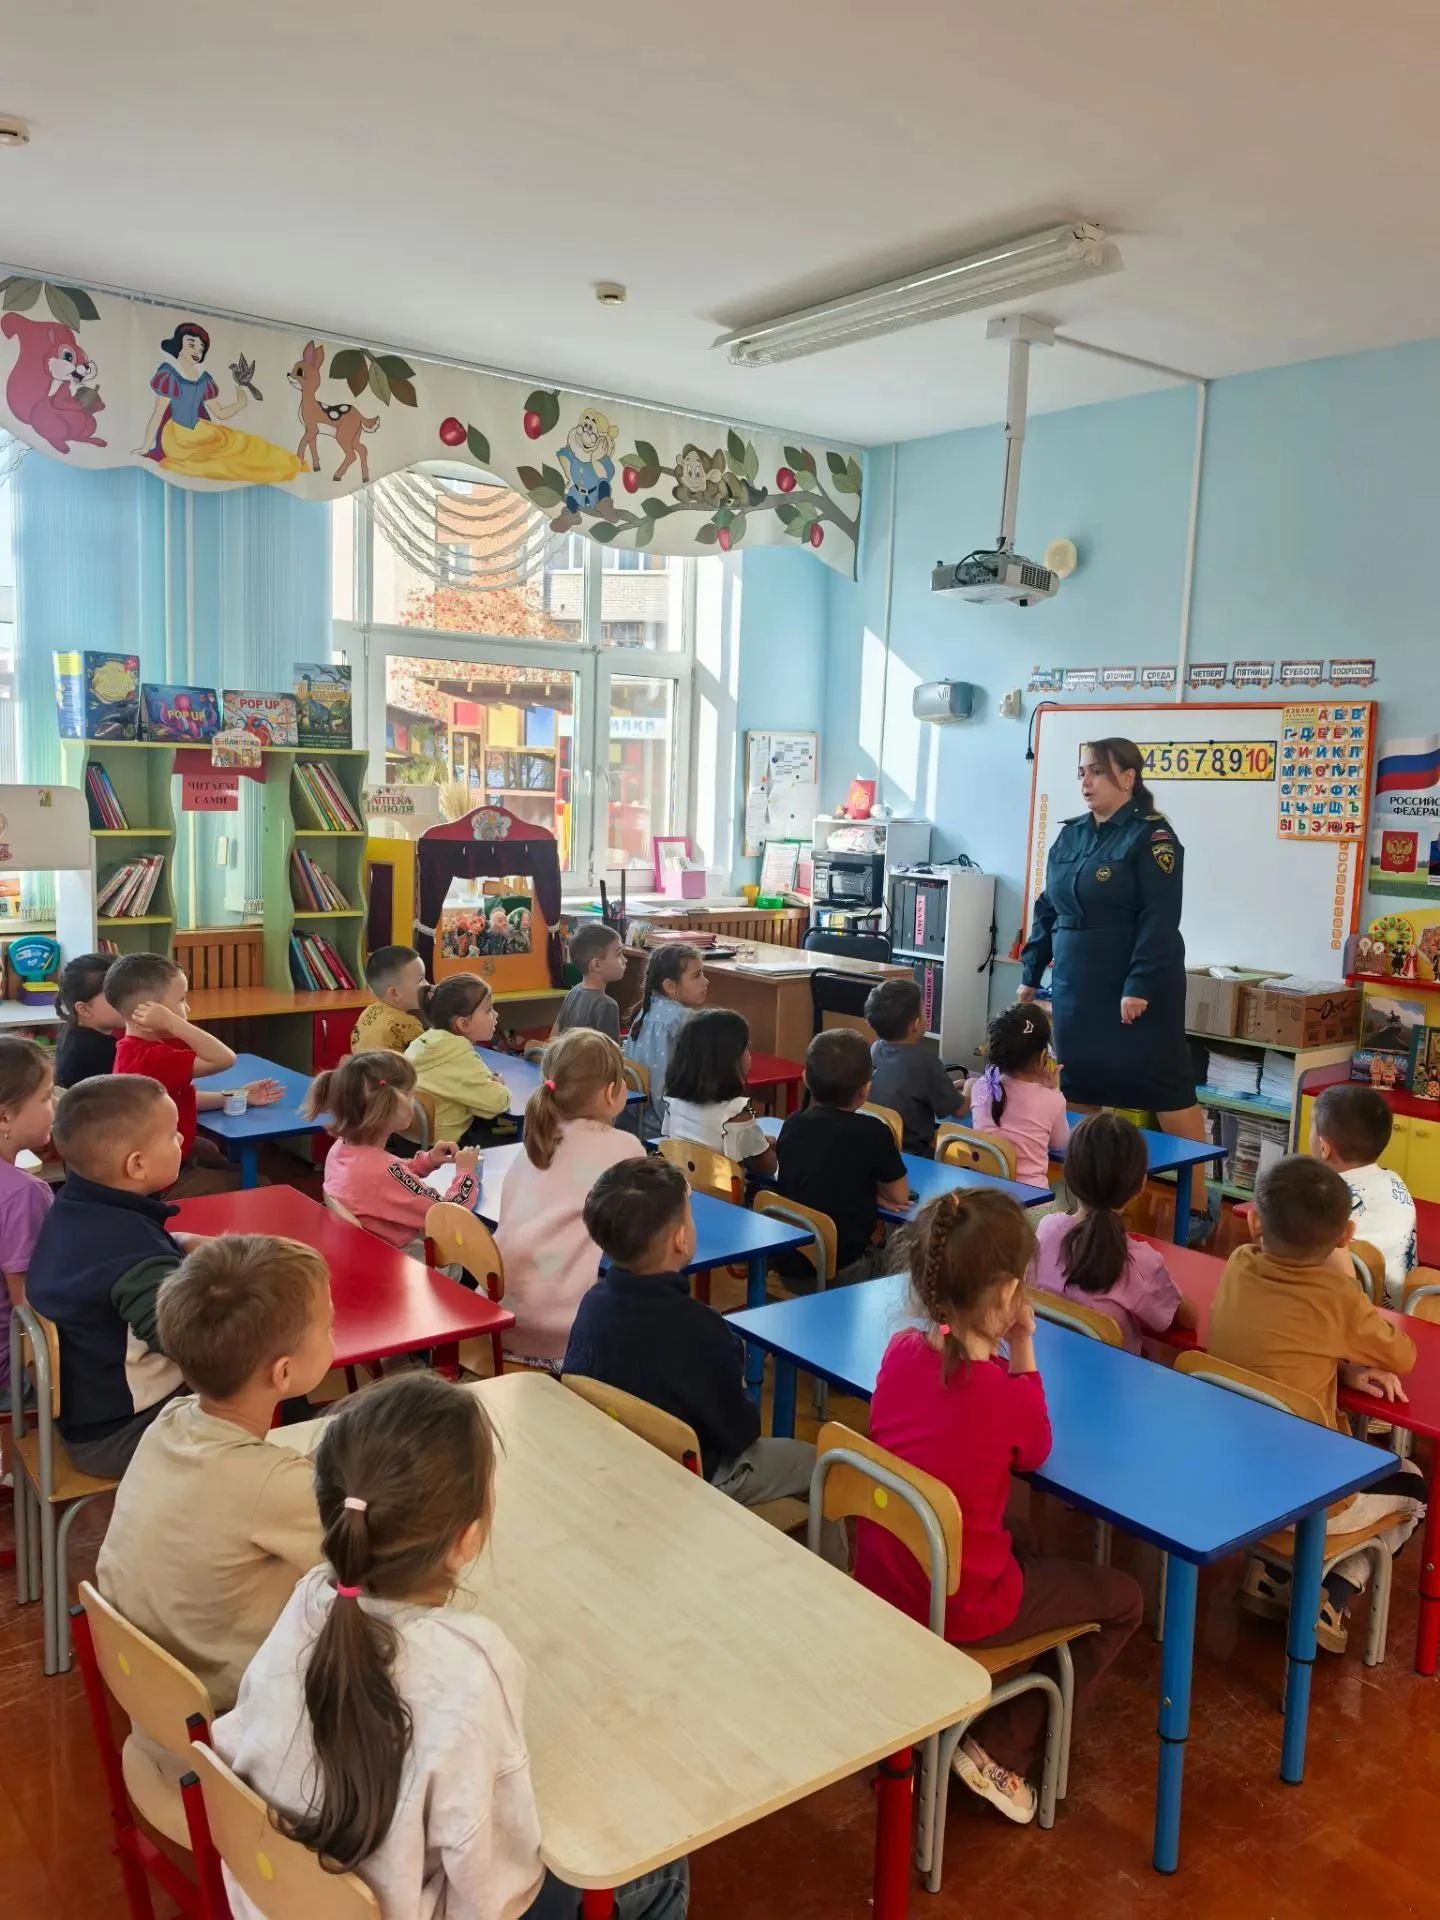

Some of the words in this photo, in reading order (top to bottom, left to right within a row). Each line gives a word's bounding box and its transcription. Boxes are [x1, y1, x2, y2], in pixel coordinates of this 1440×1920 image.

[1192, 669, 1224, 678] ЧЕТВЕРГ
[1236, 667, 1270, 676] ПЯТНИЦА
[1283, 666, 1319, 676] СУББОТА
[1106, 672, 1133, 680] ВТОРНИК
[1147, 672, 1171, 680] СРЕДА
[240, 698, 263, 710] POP
[265, 700, 280, 710] UP
[168, 710, 189, 720] POP
[191, 712, 205, 721] UP
[1318, 709, 1328, 720] А
[1335, 709, 1344, 720] Б
[1351, 708, 1361, 720] В
[1160, 749, 1172, 772] 5
[1177, 749, 1189, 772] 6
[1195, 750, 1207, 771] 7
[1212, 749, 1224, 771] 8
[1230, 749, 1242, 772] 9
[1246, 749, 1268, 772] 10
[188, 781, 234, 790] ЧИТАЕМ
[194, 796, 227, 805] САМИ
[372, 796, 412, 804] АПТЕКА
[1309, 999, 1349, 1020] Dove
